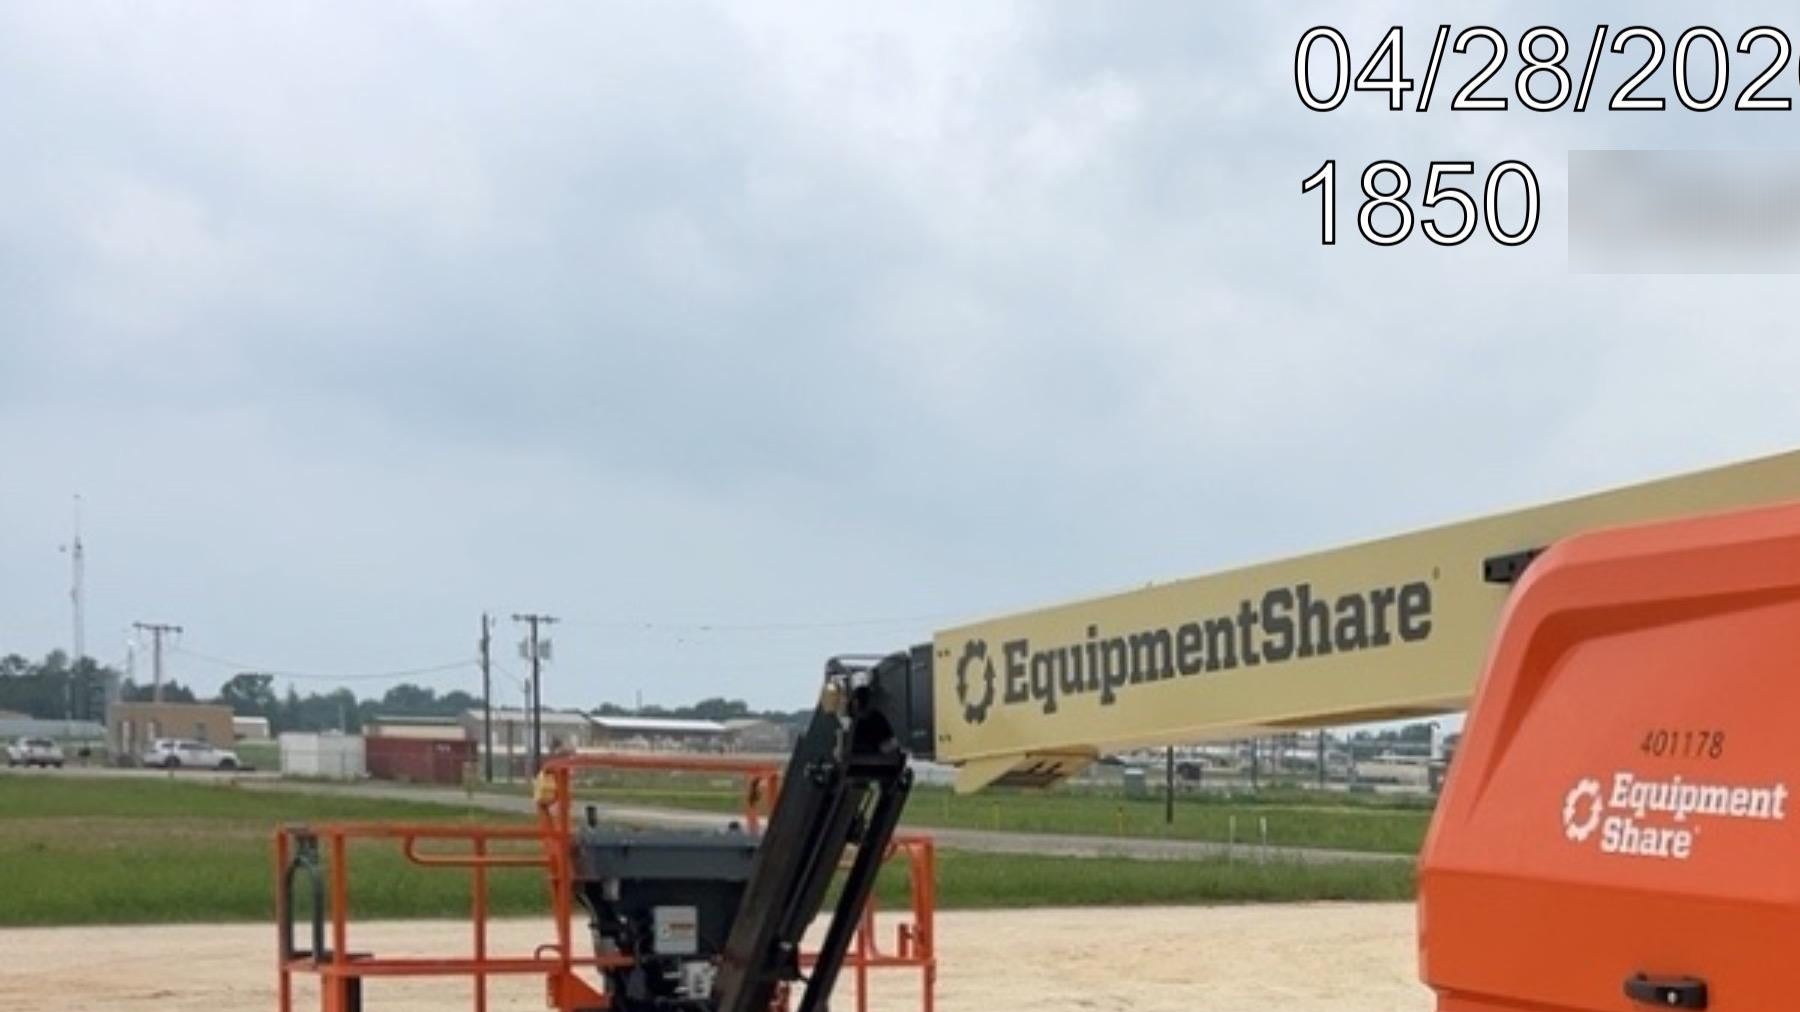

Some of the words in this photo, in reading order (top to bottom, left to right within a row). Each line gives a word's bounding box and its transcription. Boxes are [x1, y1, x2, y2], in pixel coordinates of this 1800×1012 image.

[1002, 580, 1433, 714] EquipmentShare
[1640, 730, 1725, 759] 401178
[1608, 772, 1788, 821] Equipment
[1601, 816, 1692, 859] Share
